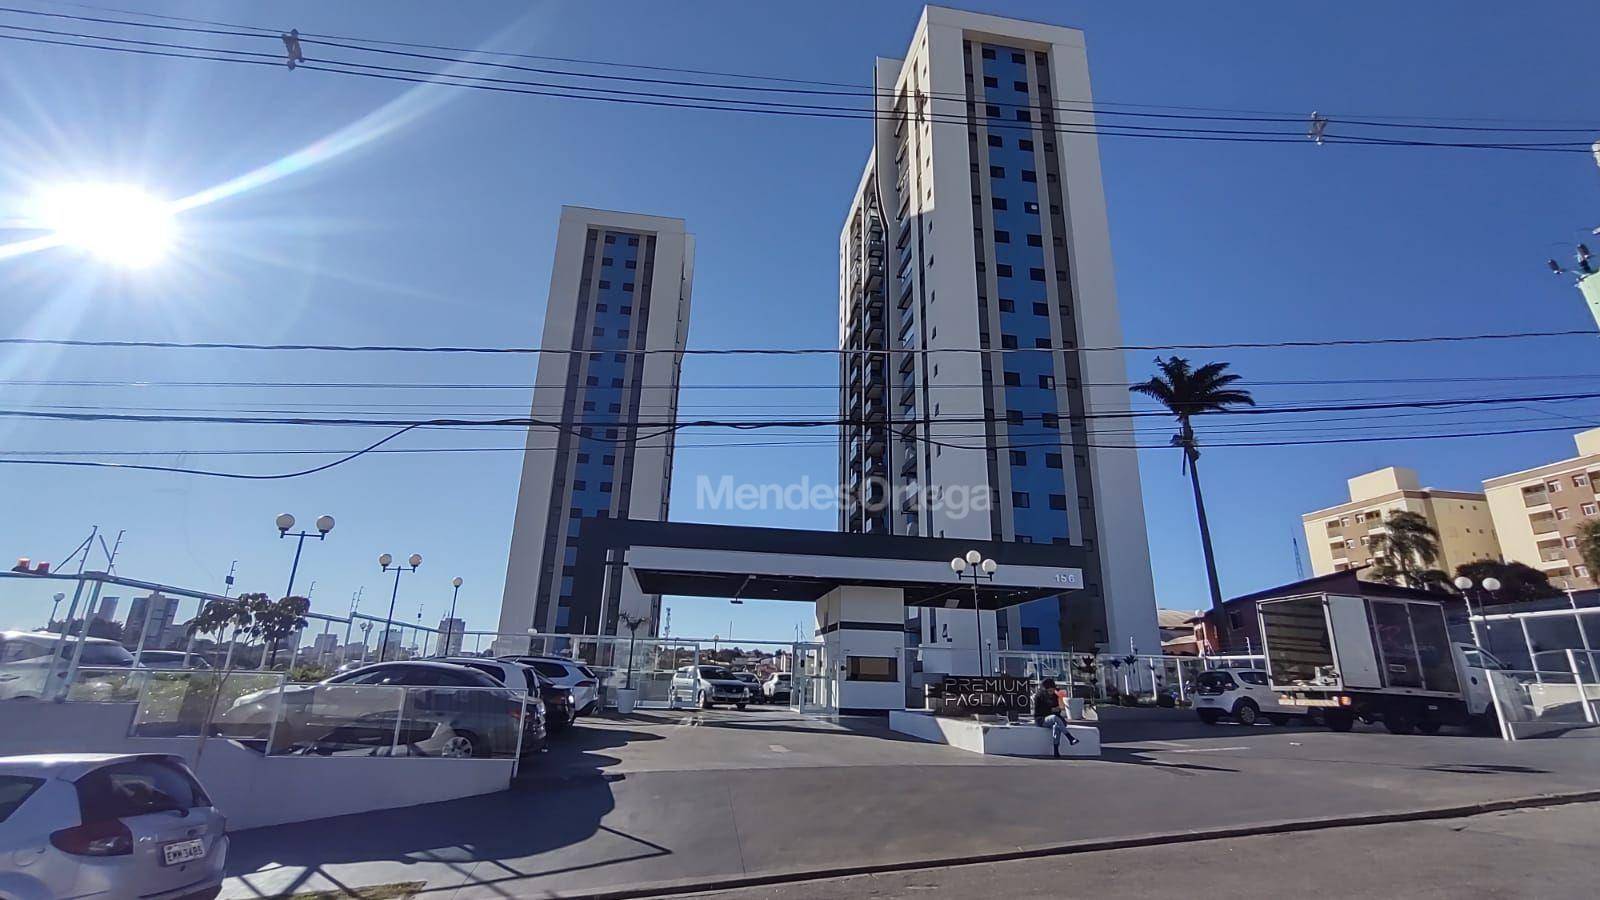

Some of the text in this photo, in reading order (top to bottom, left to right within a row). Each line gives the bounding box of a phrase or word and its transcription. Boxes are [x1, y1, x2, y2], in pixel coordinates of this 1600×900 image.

[1055, 574, 1075, 583] 156
[945, 678, 1029, 692] PREMIUM
[945, 692, 1029, 707] PAGLIATO
